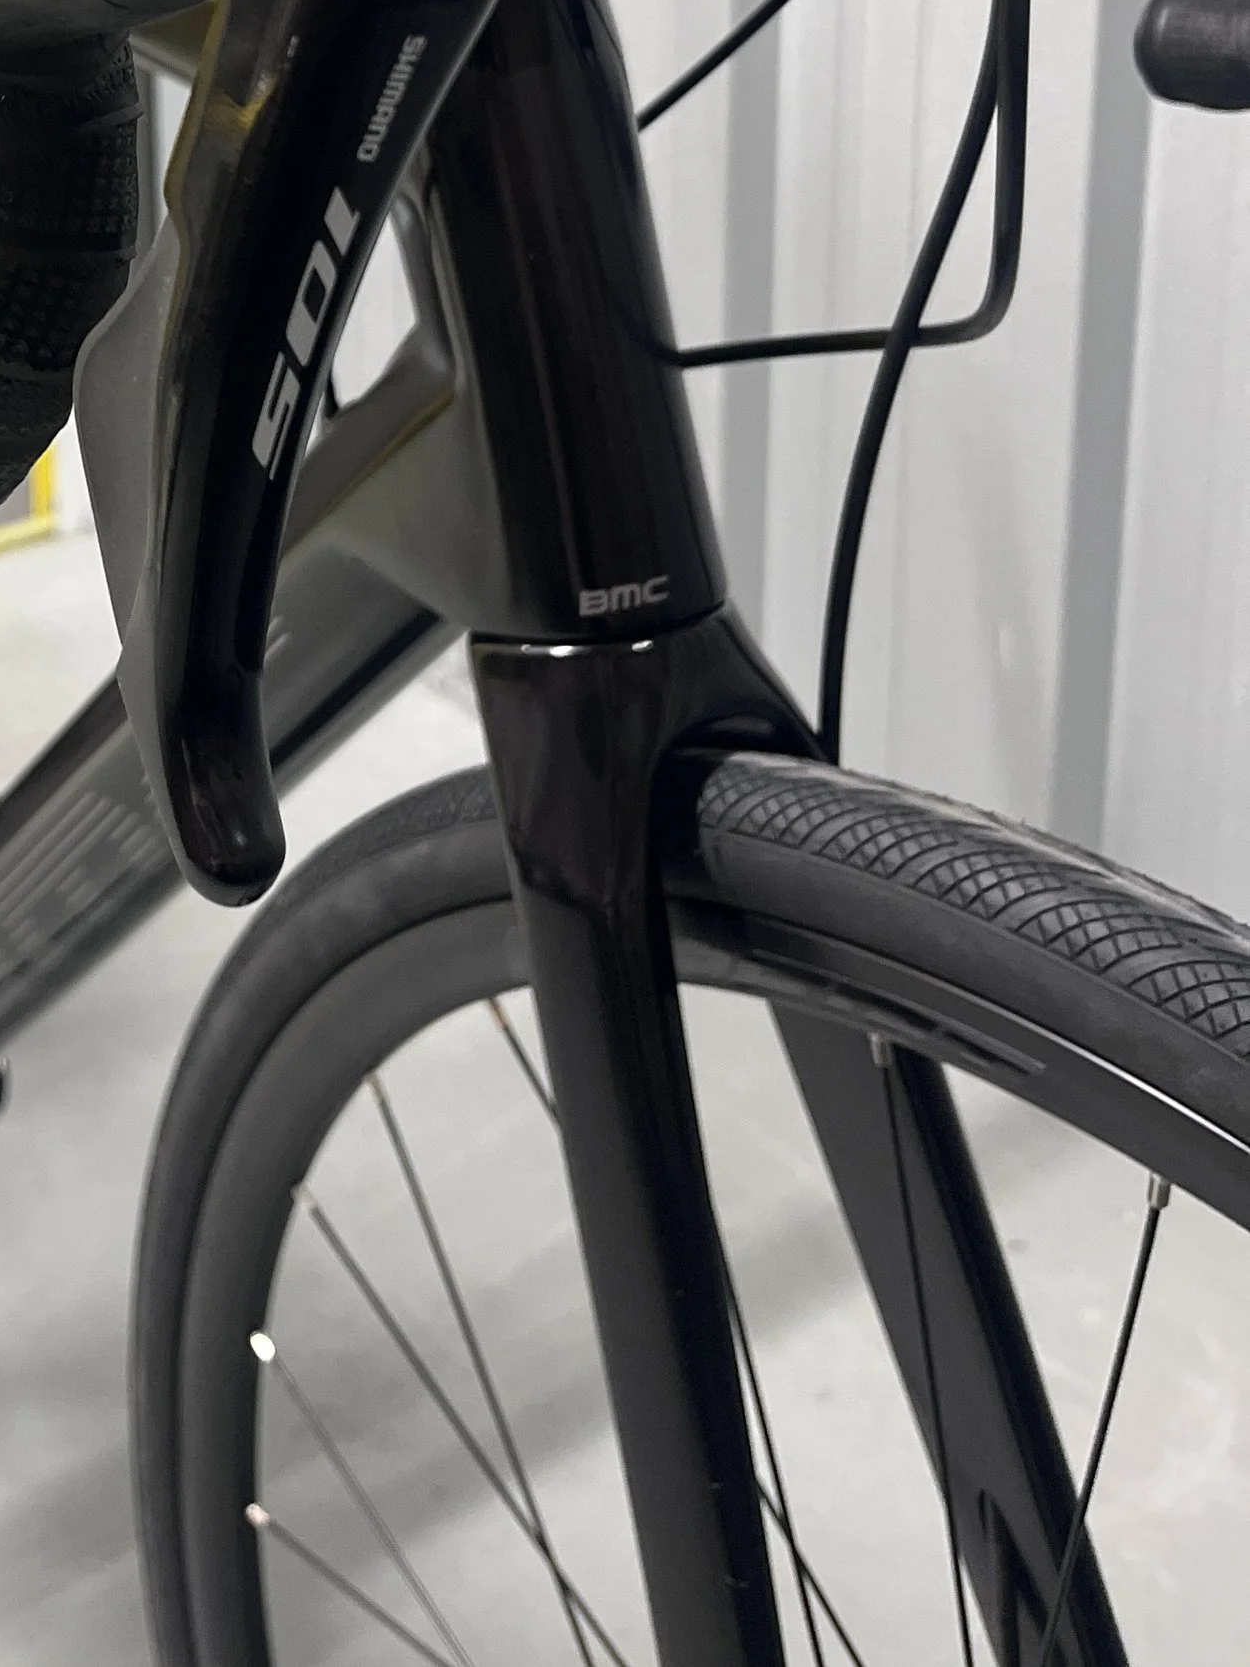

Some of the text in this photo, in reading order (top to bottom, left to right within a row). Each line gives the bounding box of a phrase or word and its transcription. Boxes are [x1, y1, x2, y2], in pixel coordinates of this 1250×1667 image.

[357, 33, 428, 162] SHIMANO
[251, 186, 361, 480] 105
[579, 575, 670, 616] BMC
